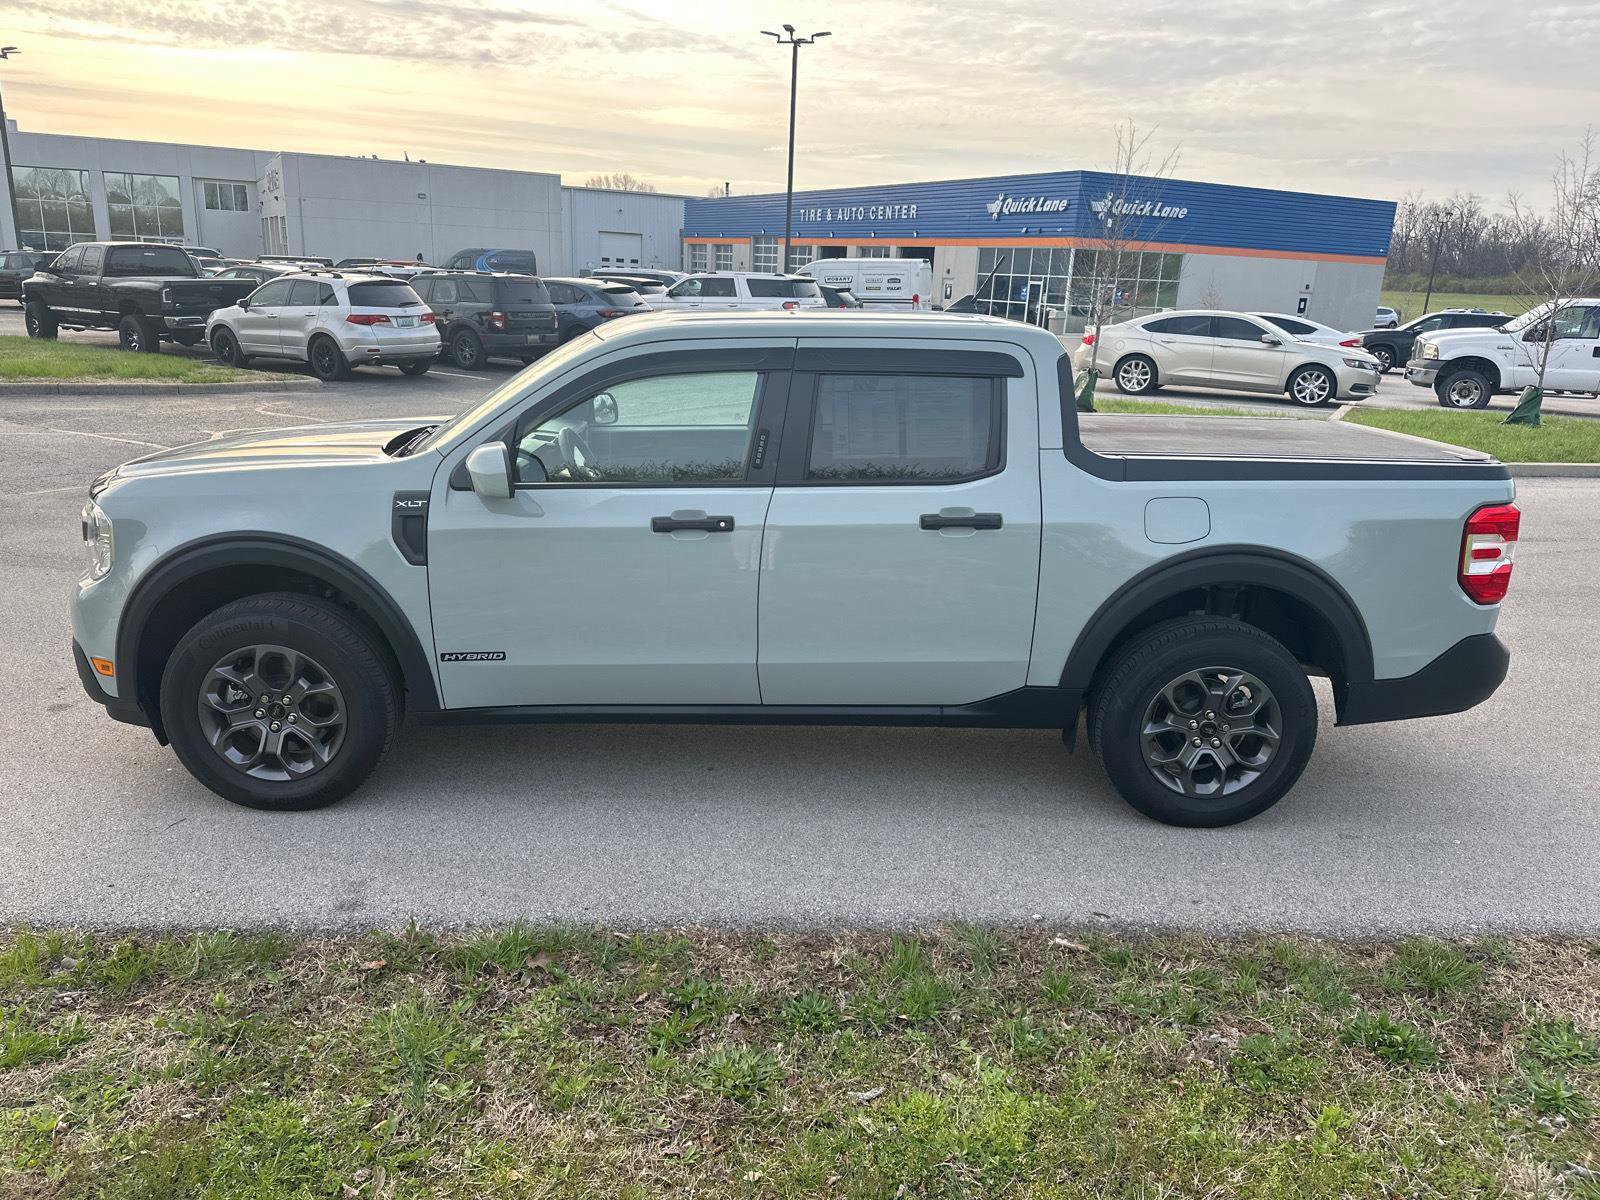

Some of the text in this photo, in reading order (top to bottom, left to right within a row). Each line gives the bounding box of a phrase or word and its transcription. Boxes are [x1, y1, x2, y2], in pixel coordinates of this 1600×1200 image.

[800, 204, 918, 221] TIRE & AUTO CENTER
[444, 653, 504, 661] HYBRID
